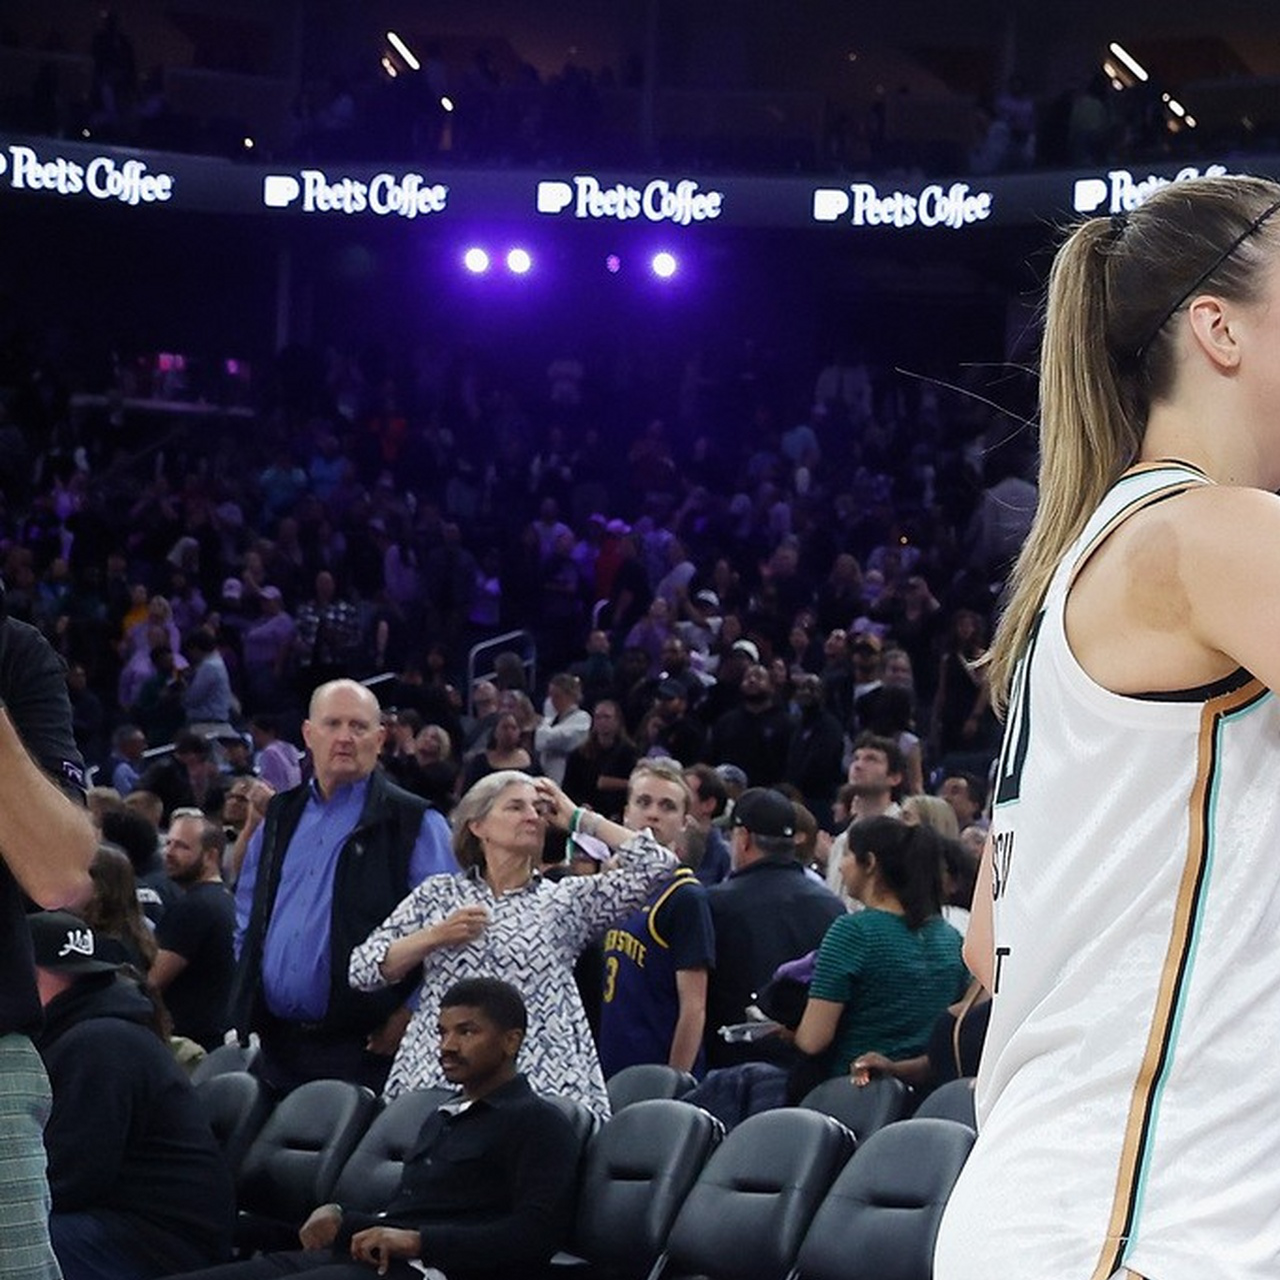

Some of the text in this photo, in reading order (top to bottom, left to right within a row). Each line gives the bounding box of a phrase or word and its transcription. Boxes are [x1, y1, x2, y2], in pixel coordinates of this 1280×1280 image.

[10, 146, 172, 206] Peet's Coffee
[301, 170, 447, 219] Peet's Coffee
[574, 175, 723, 226] Peet's Coffee
[851, 182, 992, 229] Peet's Coffee
